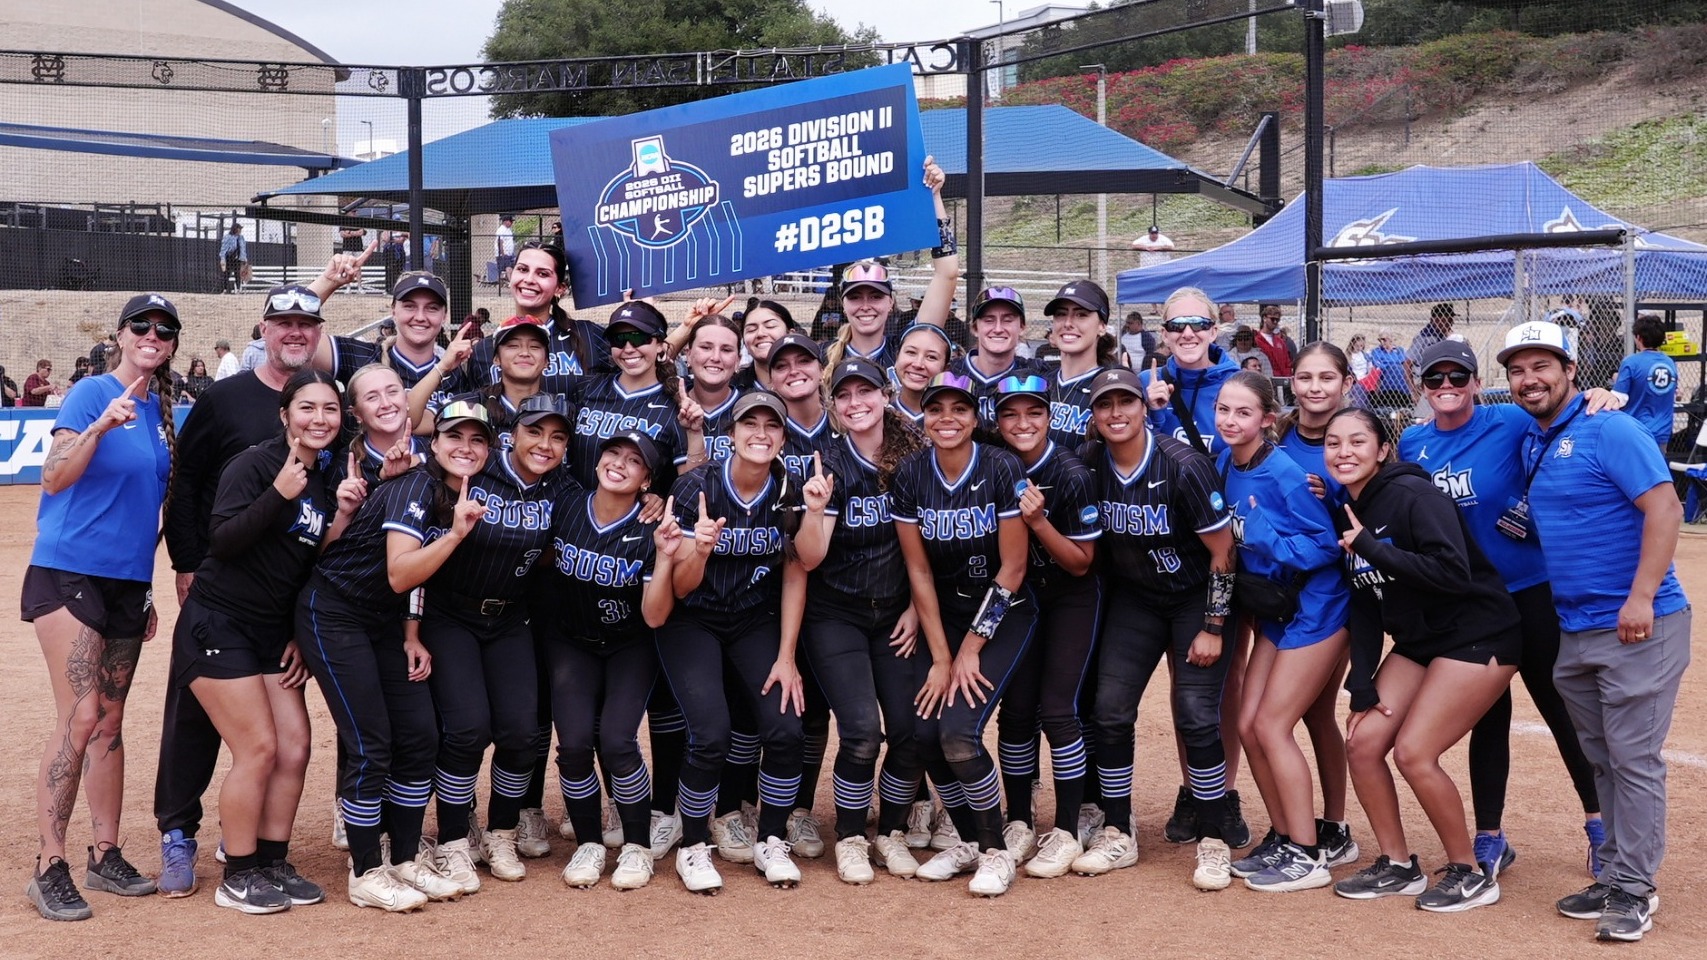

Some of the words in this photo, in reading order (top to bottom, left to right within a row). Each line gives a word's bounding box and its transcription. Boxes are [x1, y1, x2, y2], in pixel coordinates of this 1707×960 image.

[731, 127, 783, 156] 2026
[788, 109, 874, 146] DIVISION
[879, 105, 893, 129] II
[767, 135, 863, 171] SOFTBALL
[624, 182, 685, 200] SOFTBALL
[743, 164, 821, 198] SUPERS
[826, 151, 894, 184] BOUND
[600, 186, 715, 222] CHAMPIONSHIP
[774, 205, 885, 253] #D2SB
[1654, 368, 1668, 387] 25
[1432, 465, 1474, 500] SM
[296, 501, 324, 537] SM
[1099, 500, 1170, 535] SUSM
[714, 526, 782, 555] SUSM
[968, 554, 988, 578] 2
[1147, 546, 1181, 573] 18
